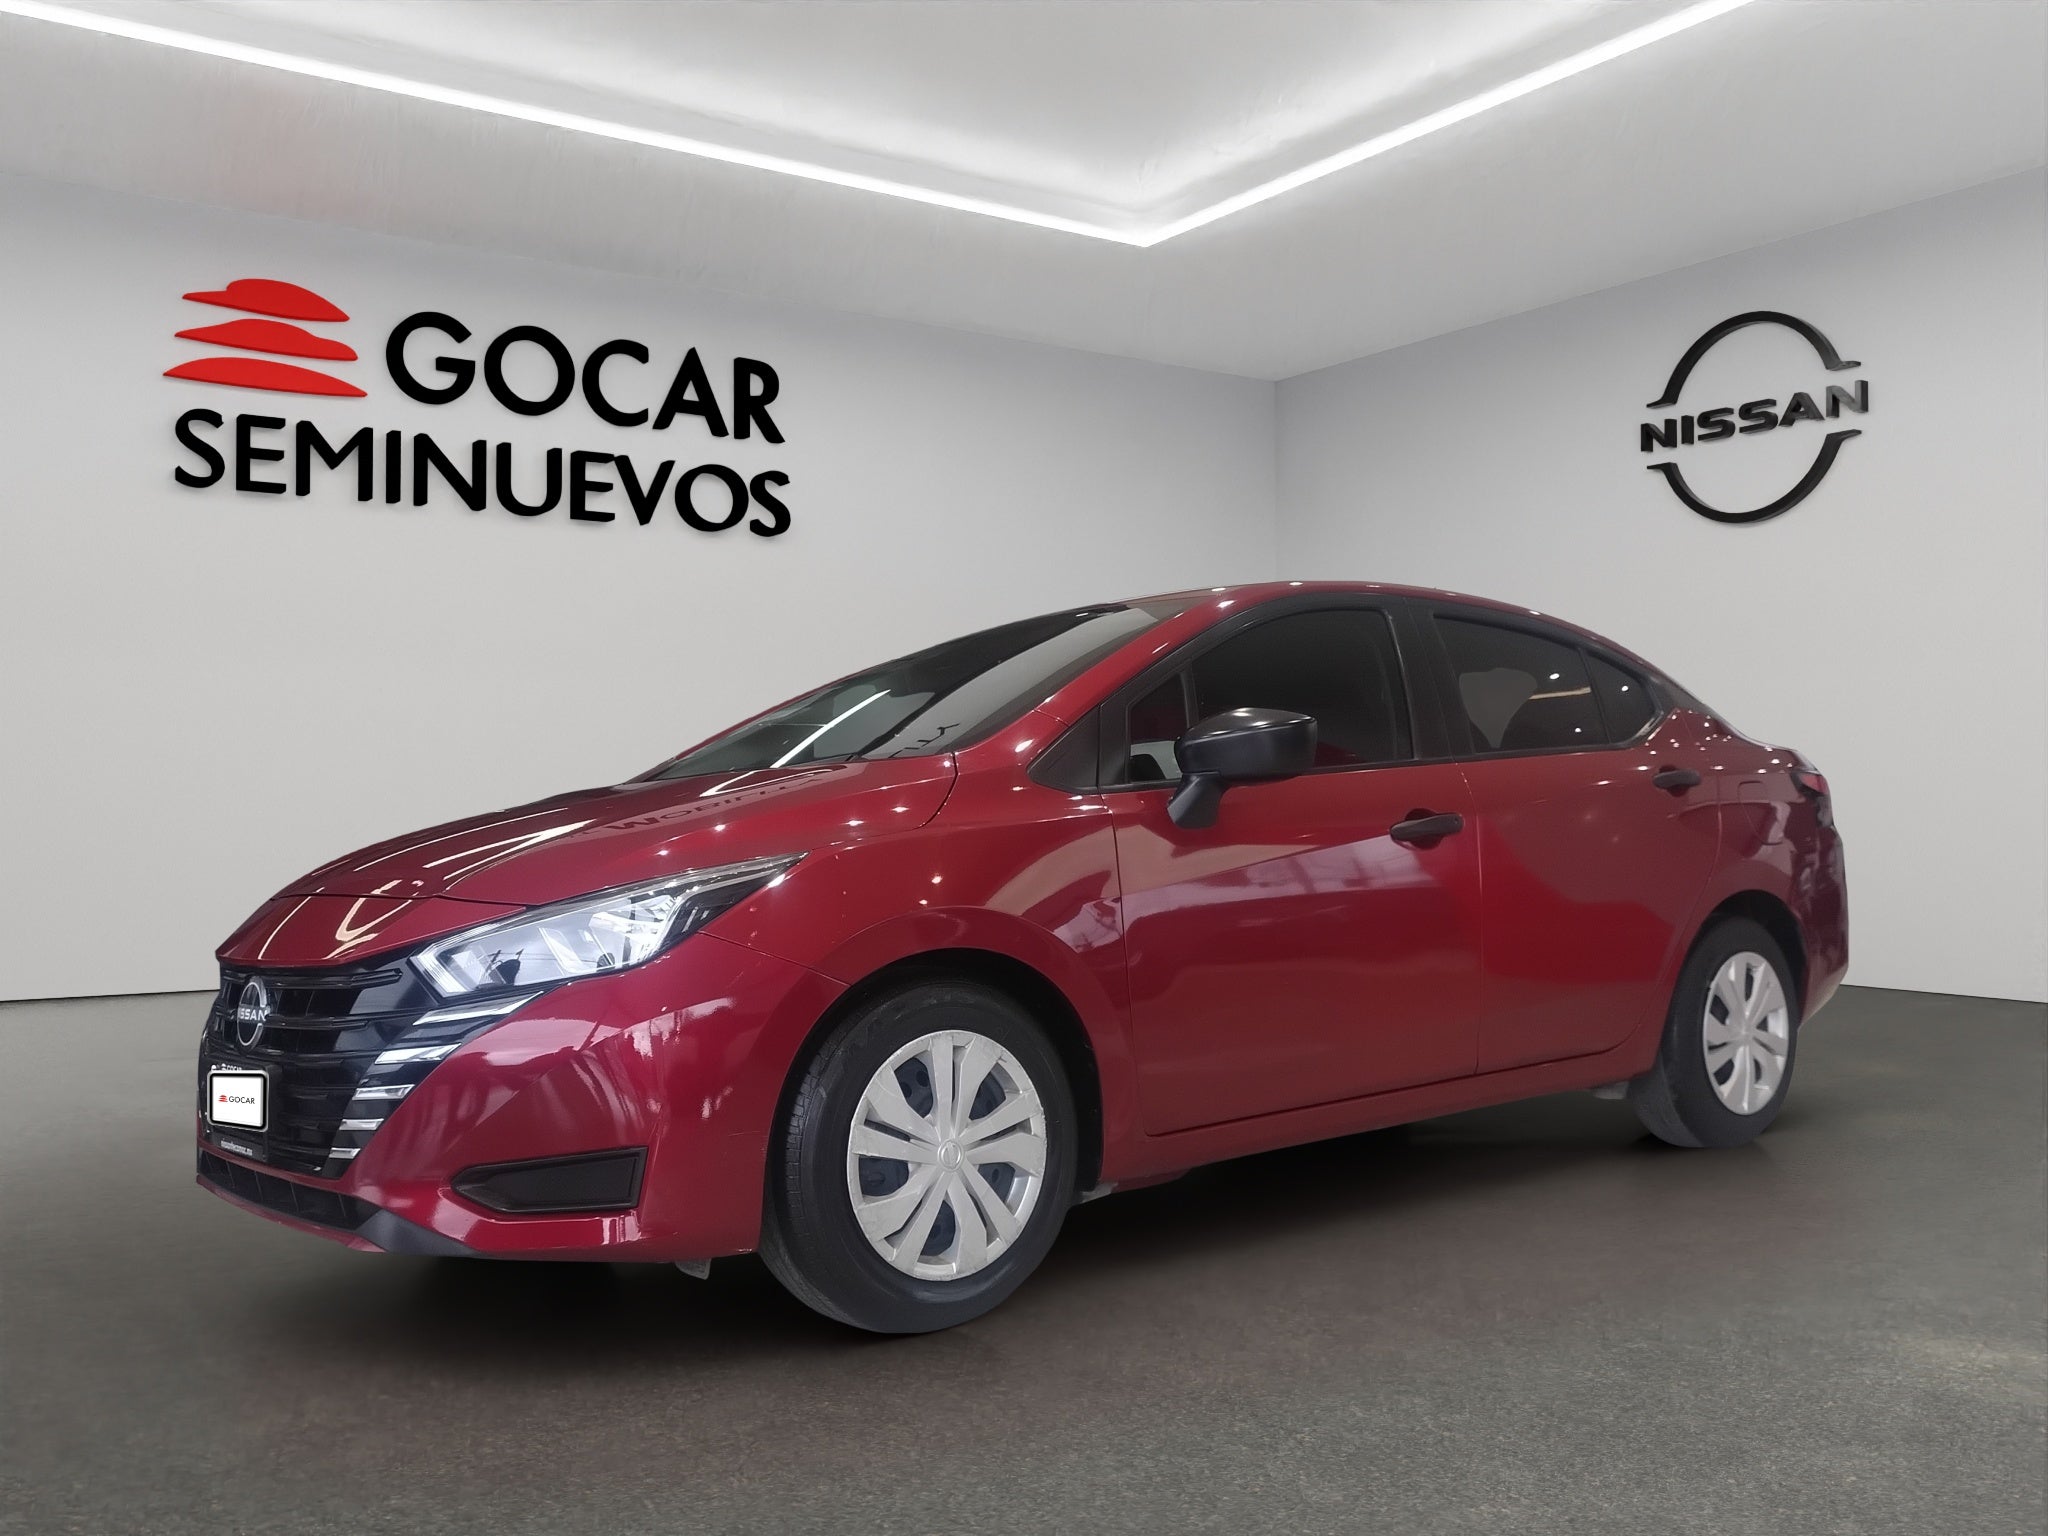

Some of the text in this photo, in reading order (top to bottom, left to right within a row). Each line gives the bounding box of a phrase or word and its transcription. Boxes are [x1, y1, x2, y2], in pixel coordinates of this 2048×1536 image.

[385, 311, 786, 444] GOCAR
[1640, 379, 1869, 453] NISSAN
[174, 408, 791, 538] SEMINUEVOS
[228, 1095, 256, 1105] GOCAR
